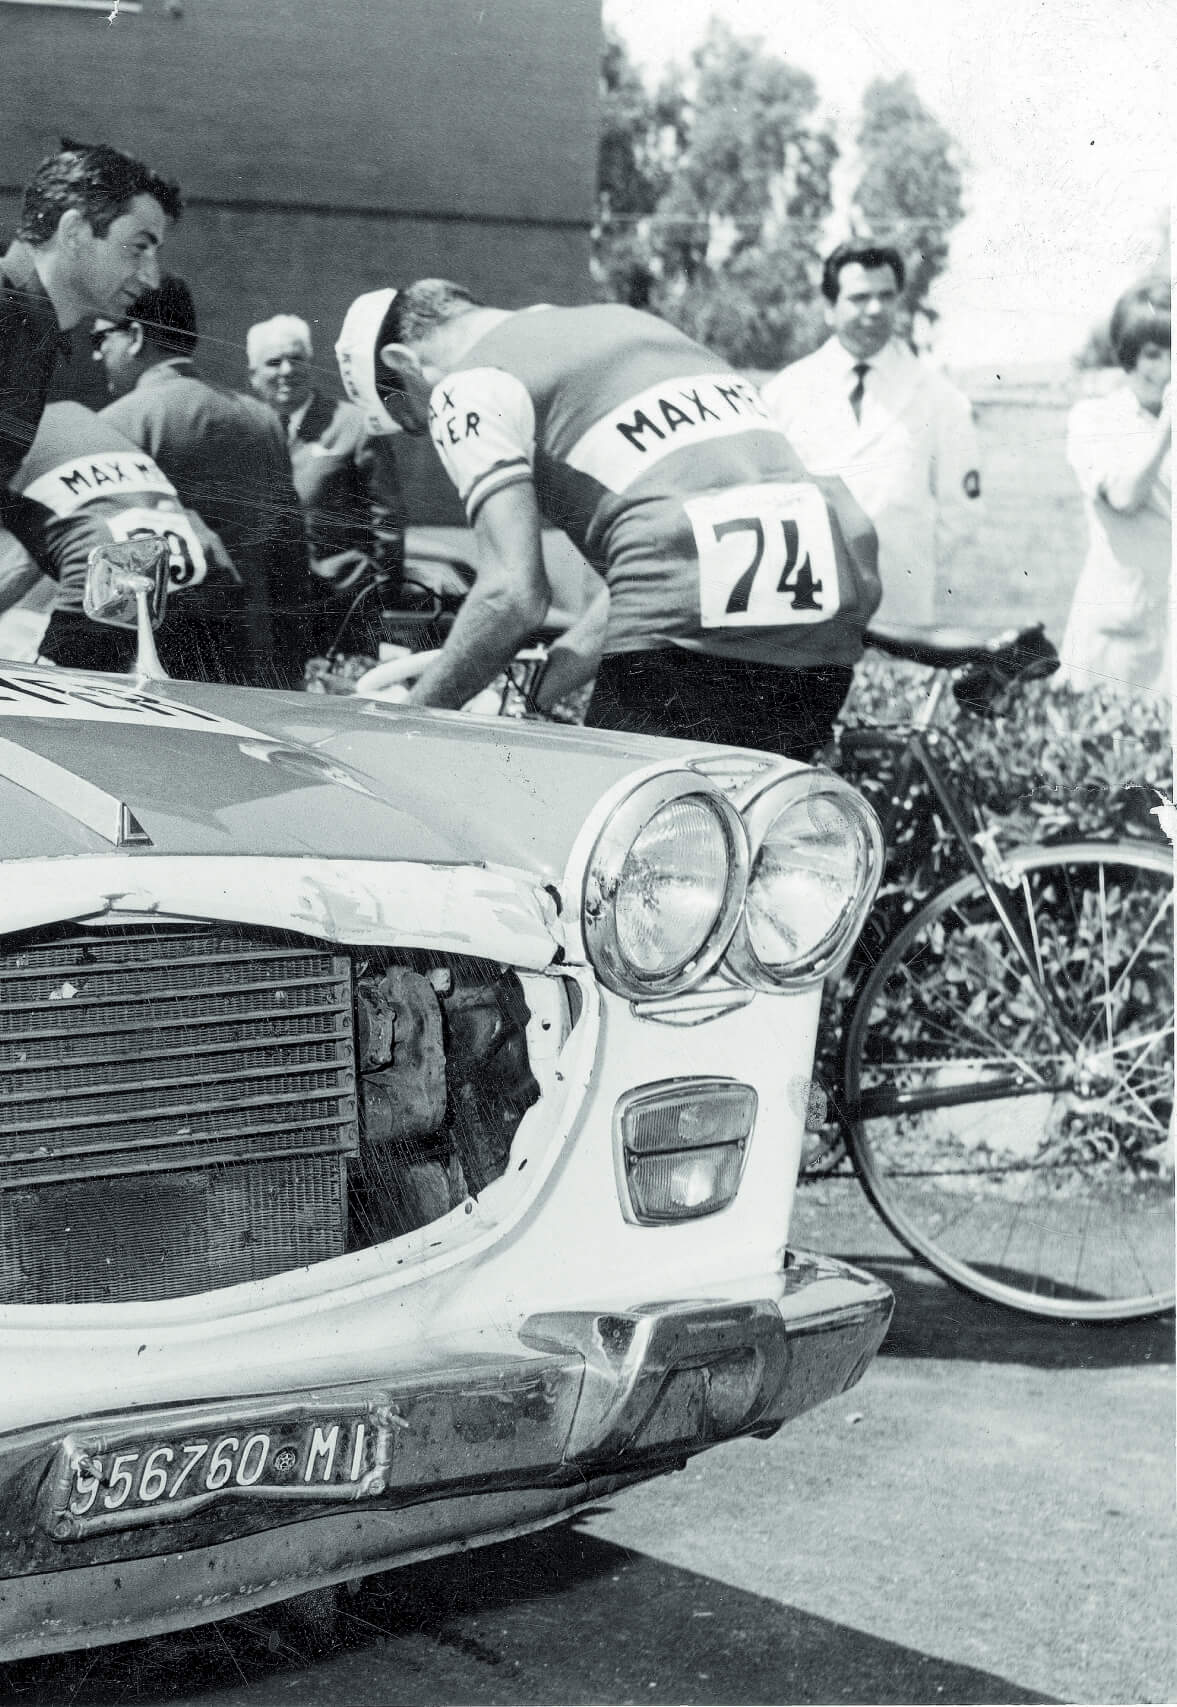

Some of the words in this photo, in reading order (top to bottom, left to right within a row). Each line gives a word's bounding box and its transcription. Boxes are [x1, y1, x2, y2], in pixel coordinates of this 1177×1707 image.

[616, 388, 721, 452] MAX
[58, 461, 130, 496] MAX
[712, 516, 823, 615] 74
[70, 1433, 271, 1515] 956760
[304, 1423, 365, 1482] MI
